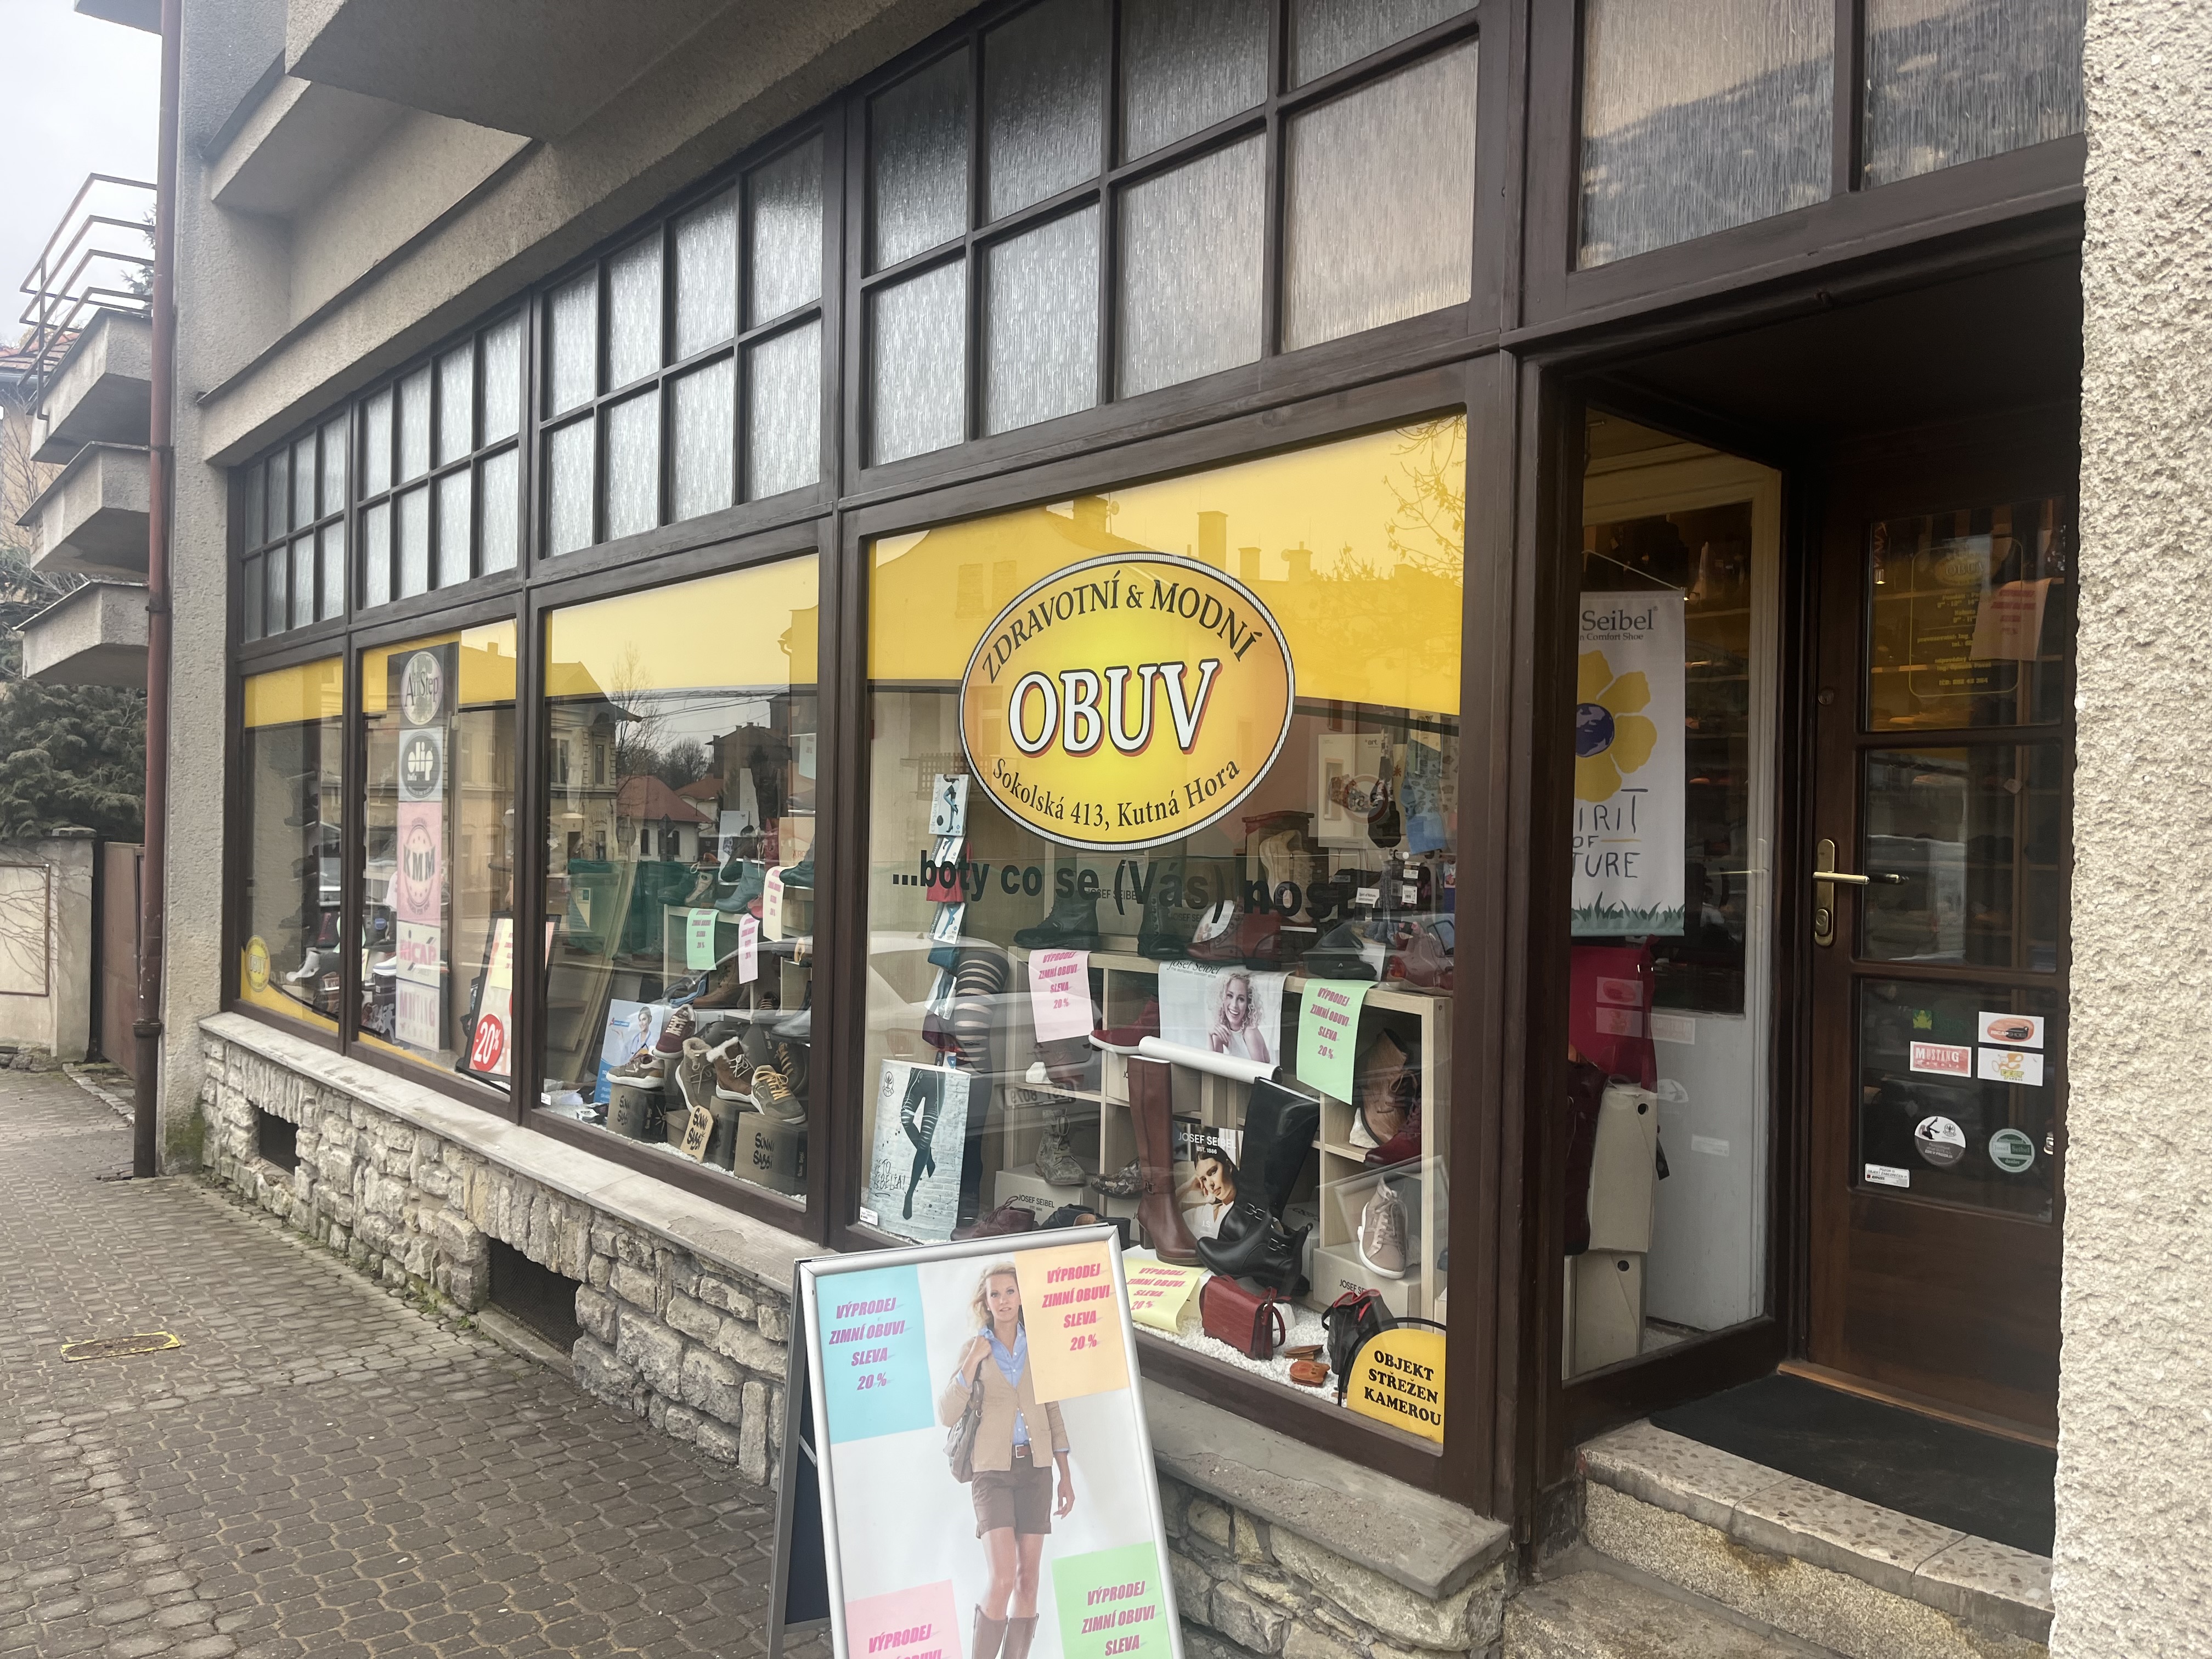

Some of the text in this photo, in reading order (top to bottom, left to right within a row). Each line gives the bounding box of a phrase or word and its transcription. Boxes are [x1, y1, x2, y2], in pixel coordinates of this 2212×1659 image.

[982, 570, 1262, 684] ZDRAVOTNÍ & MODNÍ
[1008, 658, 1223, 759] OBUV
[992, 759, 1240, 830] Sokolská 413, Kutná Hora
[1579, 789, 1648, 833] IRIT
[1572, 853, 1641, 878] TURE
[1001, 864, 1042, 896] co
[1056, 867, 1099, 900] se
[1050, 981, 1069, 994] SLEVA
[1317, 988, 1350, 1007] VÝPRODEJ
[1053, 999, 1063, 1009] 20
[1310, 1003, 1350, 1027] ZIMNÍ OBUVI
[1318, 1026, 1338, 1041] SLEVA
[1318, 1045, 1334, 1059] 20 %
[1915, 1047, 1959, 1063] MUSTANG
[1178, 1131, 1236, 1149] JOSEF SEIBEL
[1018, 1194, 1054, 1208] JOSEF SEIBEL
[1047, 1263, 1101, 1284] VÝPRODEJ
[1042, 1285, 1110, 1308] ZIMNÍ OBUVI
[1339, 1279, 1357, 1292] JOSEF
[837, 1297, 896, 1319] VÝPRODEJ
[1063, 1311, 1096, 1328] SLEVA
[829, 1321, 905, 1345] ZIMNÍ OBUVI
[1070, 1334, 1097, 1351] 20 %
[851, 1347, 888, 1367] SLEVA
[1374, 1350, 1434, 1381] OBJEKT
[856, 1372, 887, 1391] 20 %
[1369, 1368, 1438, 1404] STŘEŽEN
[1364, 1386, 1441, 1426] KAMEROU
[1087, 1581, 1146, 1606] VÝPRODEJ
[1081, 1605, 1155, 1634] ZIMNÍ OBUVI
[868, 1623, 932, 1654] VÝPRODEJ
[1105, 1634, 1139, 1656] SLEVA
